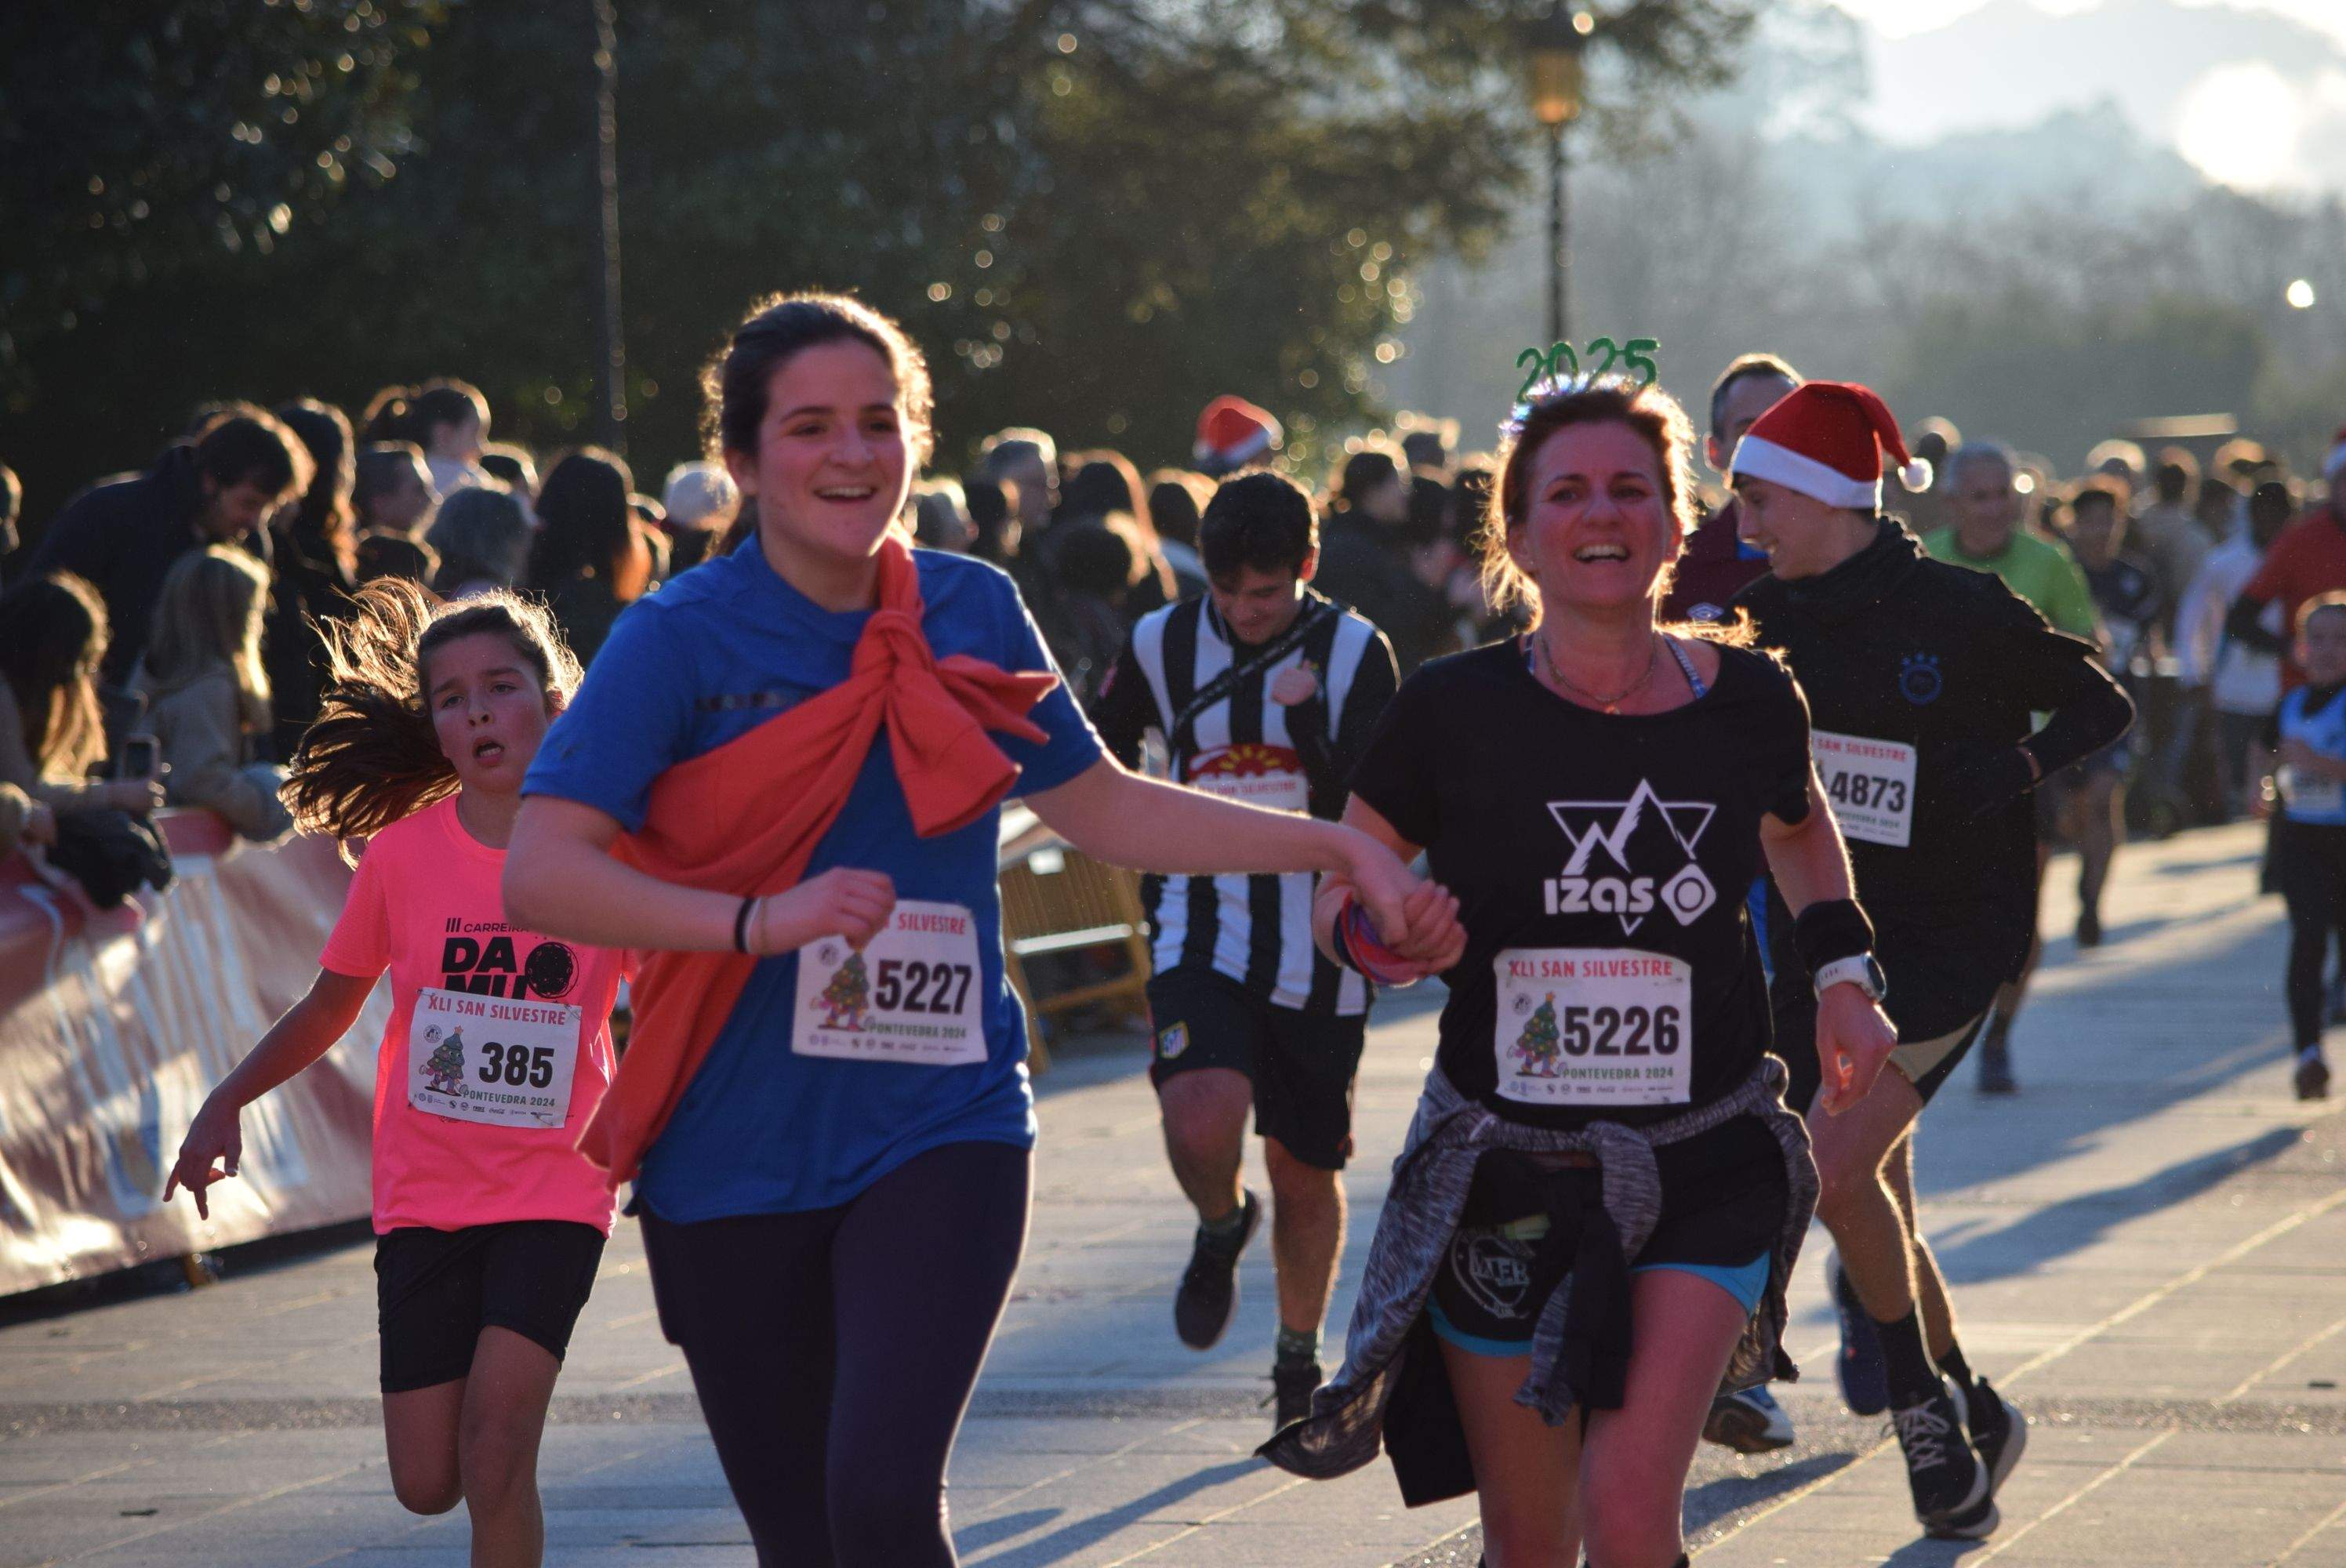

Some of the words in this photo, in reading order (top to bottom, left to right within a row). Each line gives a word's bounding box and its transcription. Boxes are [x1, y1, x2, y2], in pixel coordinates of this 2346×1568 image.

[1516, 337, 1660, 403] 2025
[1830, 771, 1906, 813] 4873
[445, 917, 462, 932] III
[898, 912, 966, 935] SILVESTRE
[441, 936, 518, 973] DA
[1509, 960, 1534, 978] XLI
[1542, 960, 1574, 978] SAN
[1582, 960, 1673, 978] SILVESTRE
[875, 959, 972, 1015] 5227
[428, 995, 452, 1012] XLI
[456, 1000, 485, 1018] SAN
[490, 1003, 566, 1025] SILVESTRE
[870, 1022, 939, 1037] PONTEVEDRA
[942, 1026, 967, 1038] 2024
[1563, 1005, 1680, 1057] 5226
[478, 1041, 555, 1089] 385
[1563, 1067, 1640, 1080] PONTEVEDRA
[1646, 1067, 1674, 1080] 2024
[463, 1090, 526, 1105] PONTEVEDRA
[530, 1097, 555, 1107] 2024
